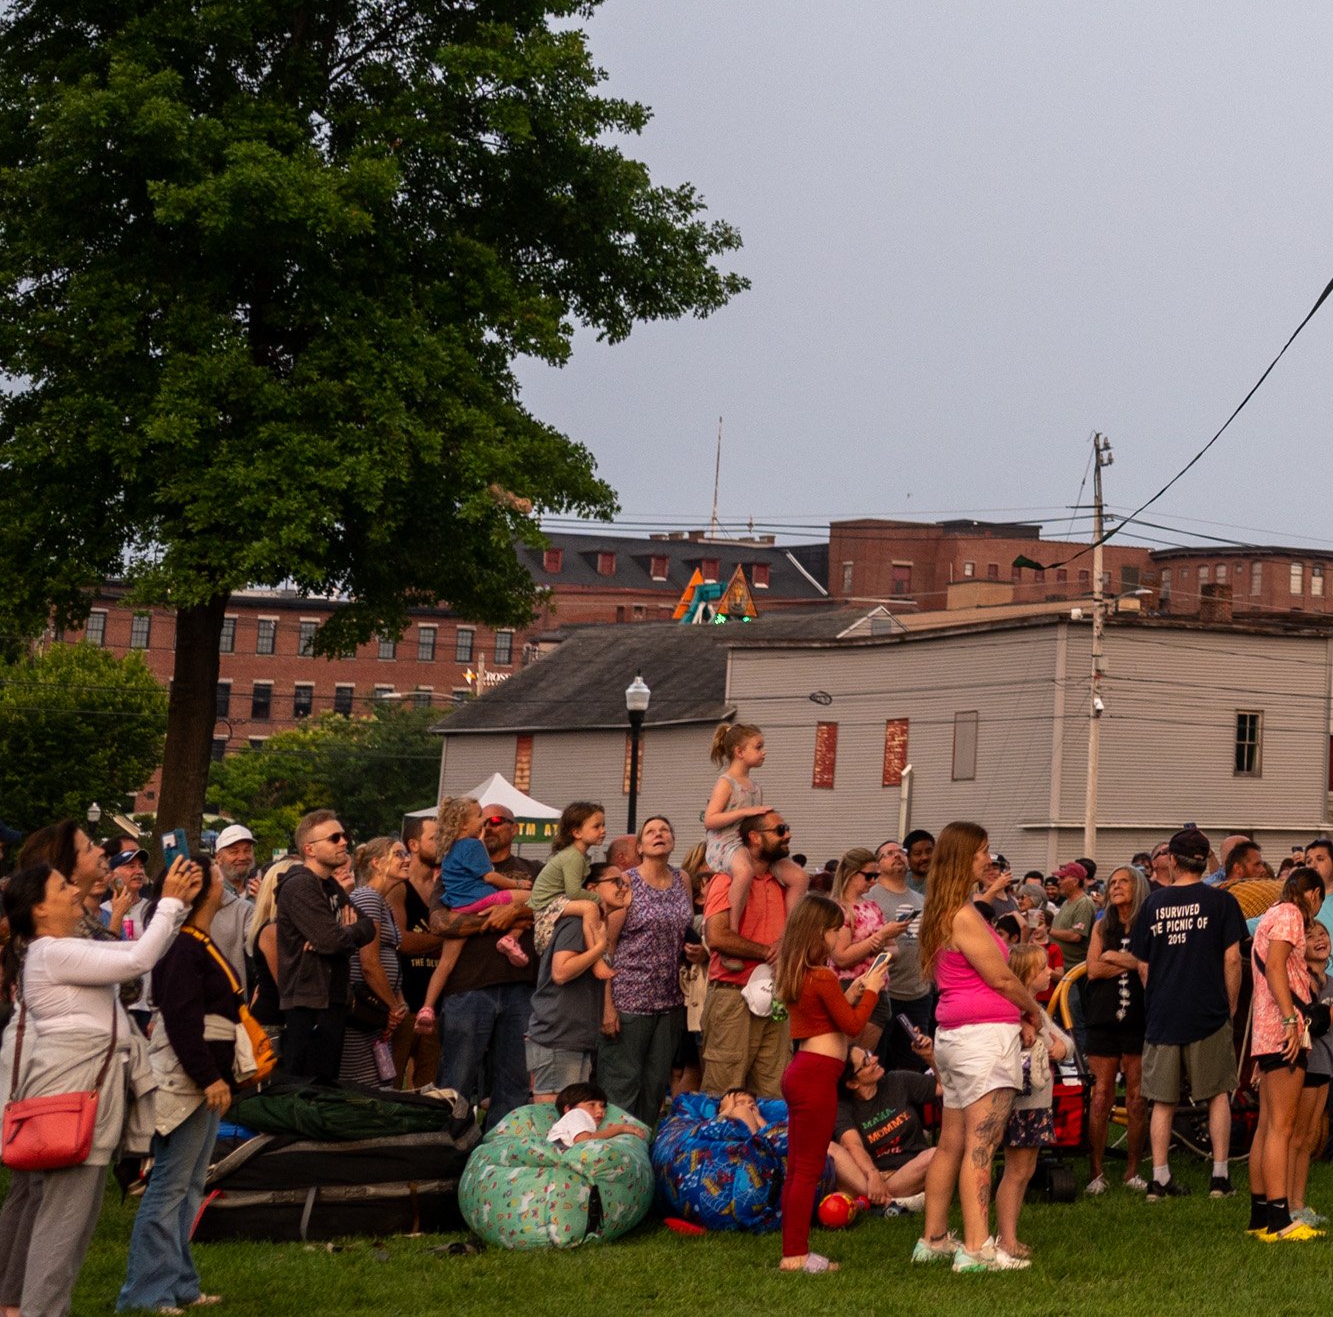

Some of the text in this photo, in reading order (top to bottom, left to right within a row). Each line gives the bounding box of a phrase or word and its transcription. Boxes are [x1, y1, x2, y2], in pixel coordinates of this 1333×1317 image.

[1156, 903, 1200, 920] I SURVIVED
[1166, 918, 1194, 933] PICNIC
[1196, 917, 1209, 929] OF
[1168, 933, 1187, 945] 2015
[867, 1111, 912, 1143] MOMMY
